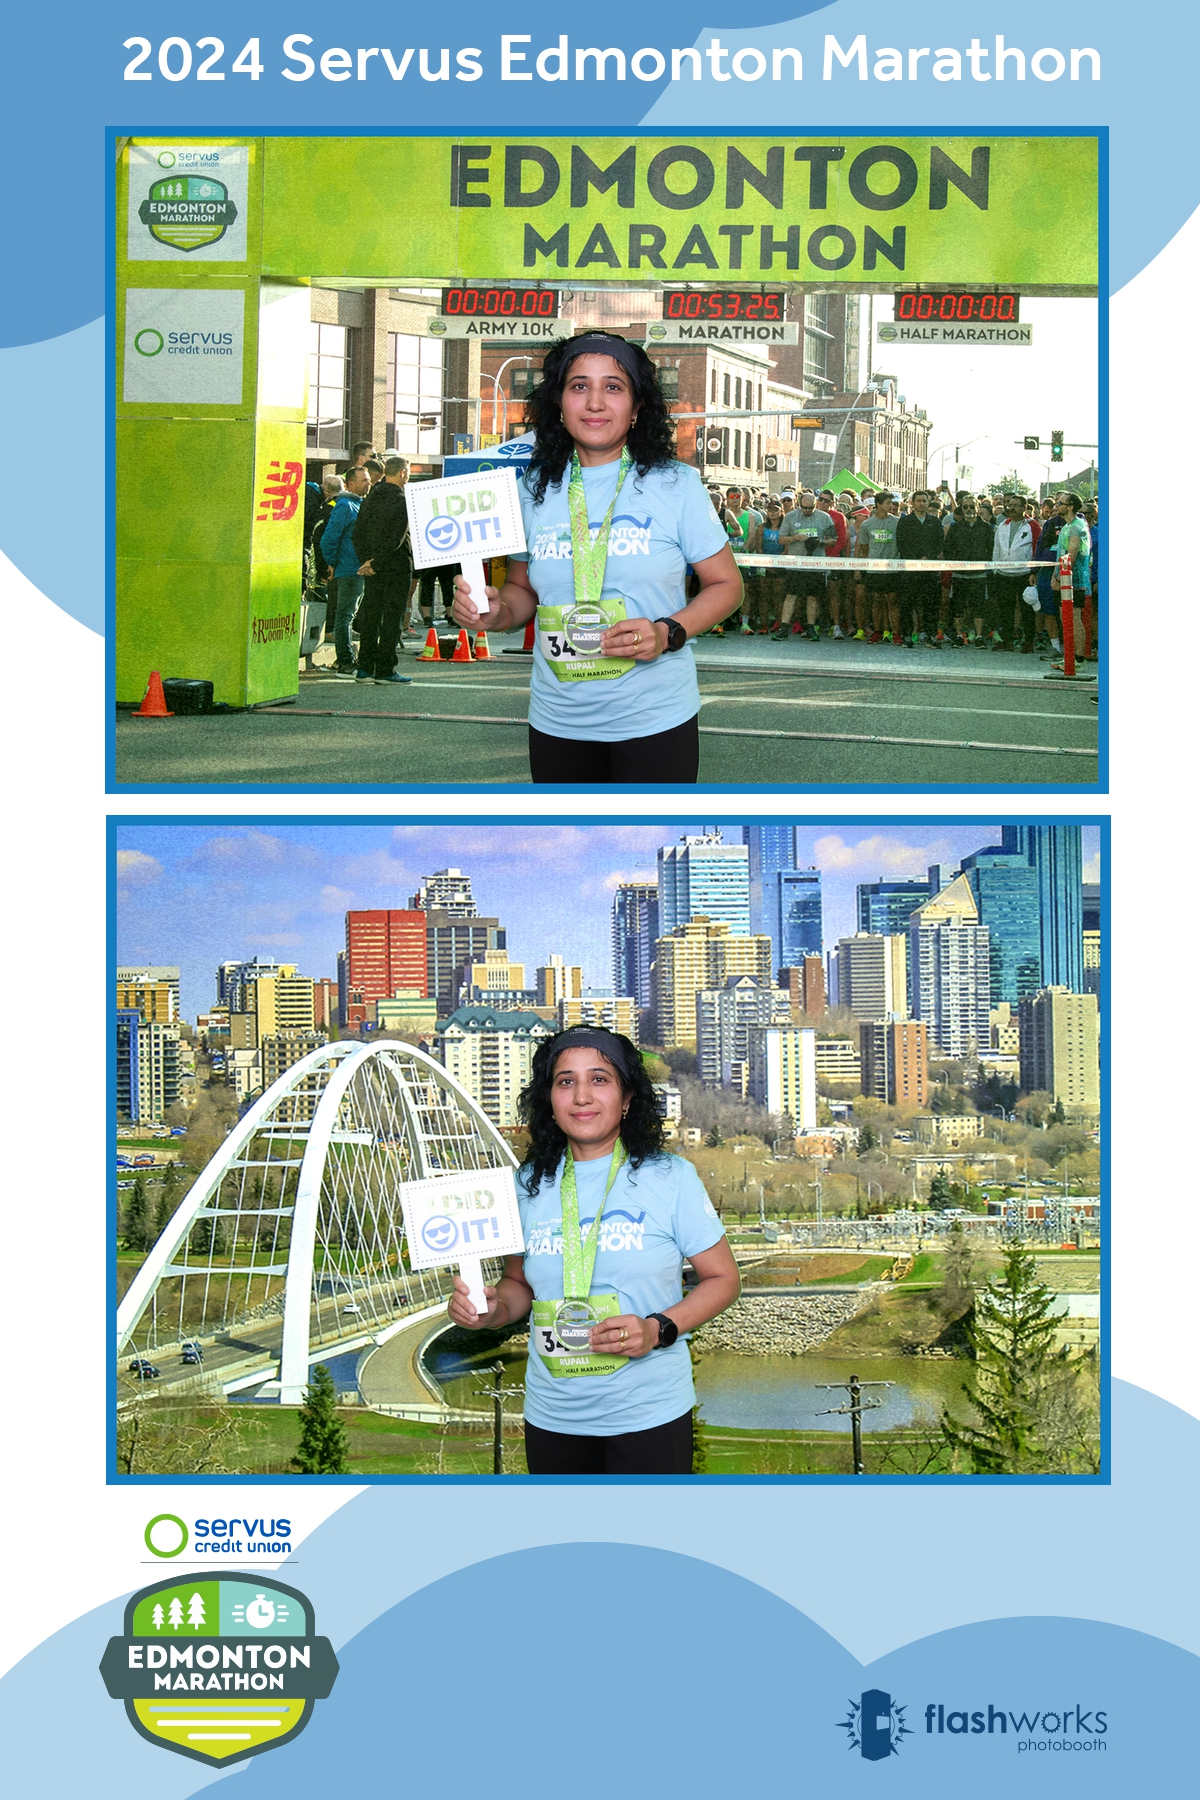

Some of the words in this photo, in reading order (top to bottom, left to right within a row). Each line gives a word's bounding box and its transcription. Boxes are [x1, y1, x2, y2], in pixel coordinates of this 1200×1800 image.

[178, 152, 220, 161] servus
[450, 144, 990, 210] EDMONTON
[149, 203, 227, 214] EDMONTON
[160, 214, 215, 222] MARATHON
[522, 223, 907, 271] MARATHON
[466, 321, 518, 335] ARMY
[521, 322, 554, 336] 10K
[678, 325, 785, 340] MARATHON
[901, 328, 939, 340] HALF
[942, 329, 1031, 341] MARATHON
[168, 332, 233, 345] servus
[168, 345, 200, 355] credit
[203, 347, 233, 355] union
[431, 498, 440, 517] I
[446, 490, 498, 516] DID
[464, 516, 502, 543] IT!
[566, 662, 596, 671] RUPALI
[462, 1216, 500, 1243] IT!
[560, 1357, 589, 1366] RUPALI
